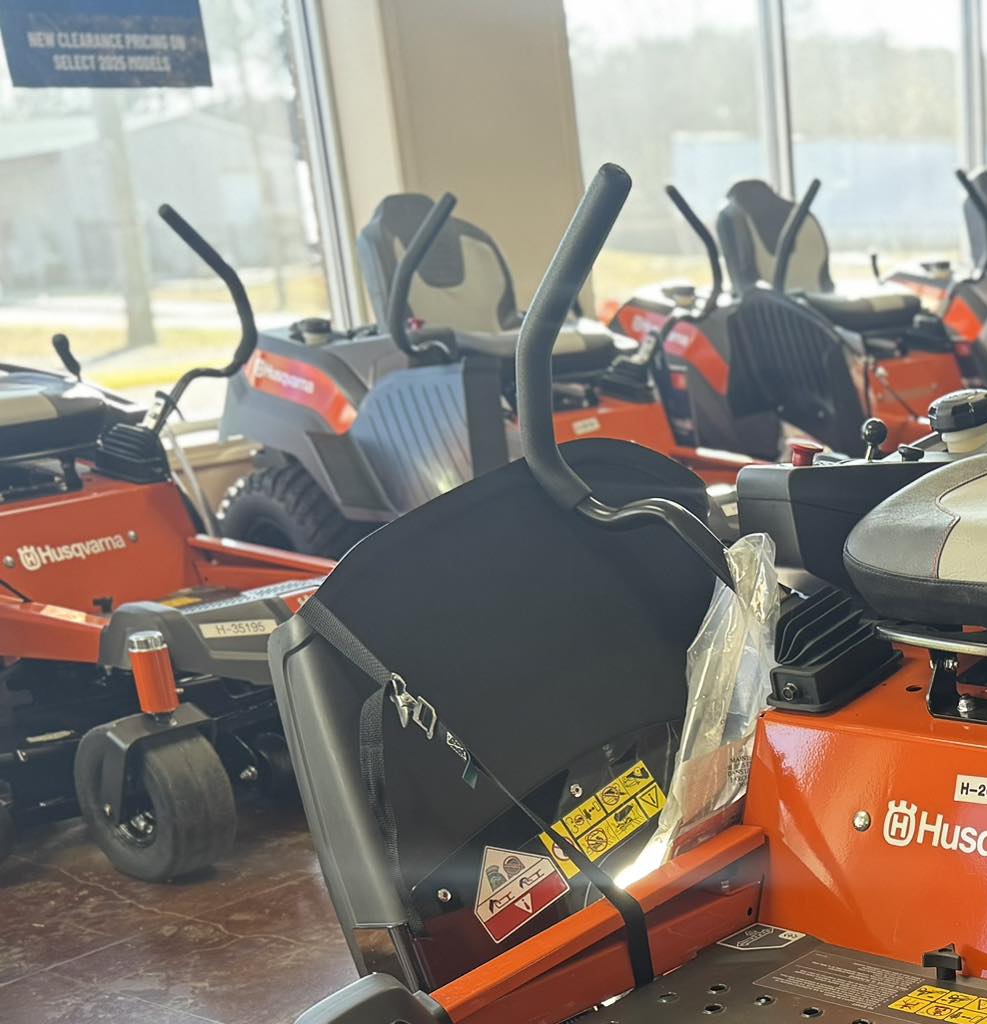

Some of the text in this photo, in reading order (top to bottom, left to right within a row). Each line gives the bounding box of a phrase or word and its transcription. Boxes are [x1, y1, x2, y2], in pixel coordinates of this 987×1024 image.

[27, 32, 55, 48] NEW
[57, 32, 123, 49] CLEARANCE
[125, 33, 168, 49] PRICING
[53, 54, 95, 71] SELECT
[128, 56, 171, 72] MODELS
[37, 533, 126, 565] Husqvarna
[216, 622, 265, 635] H-35195
